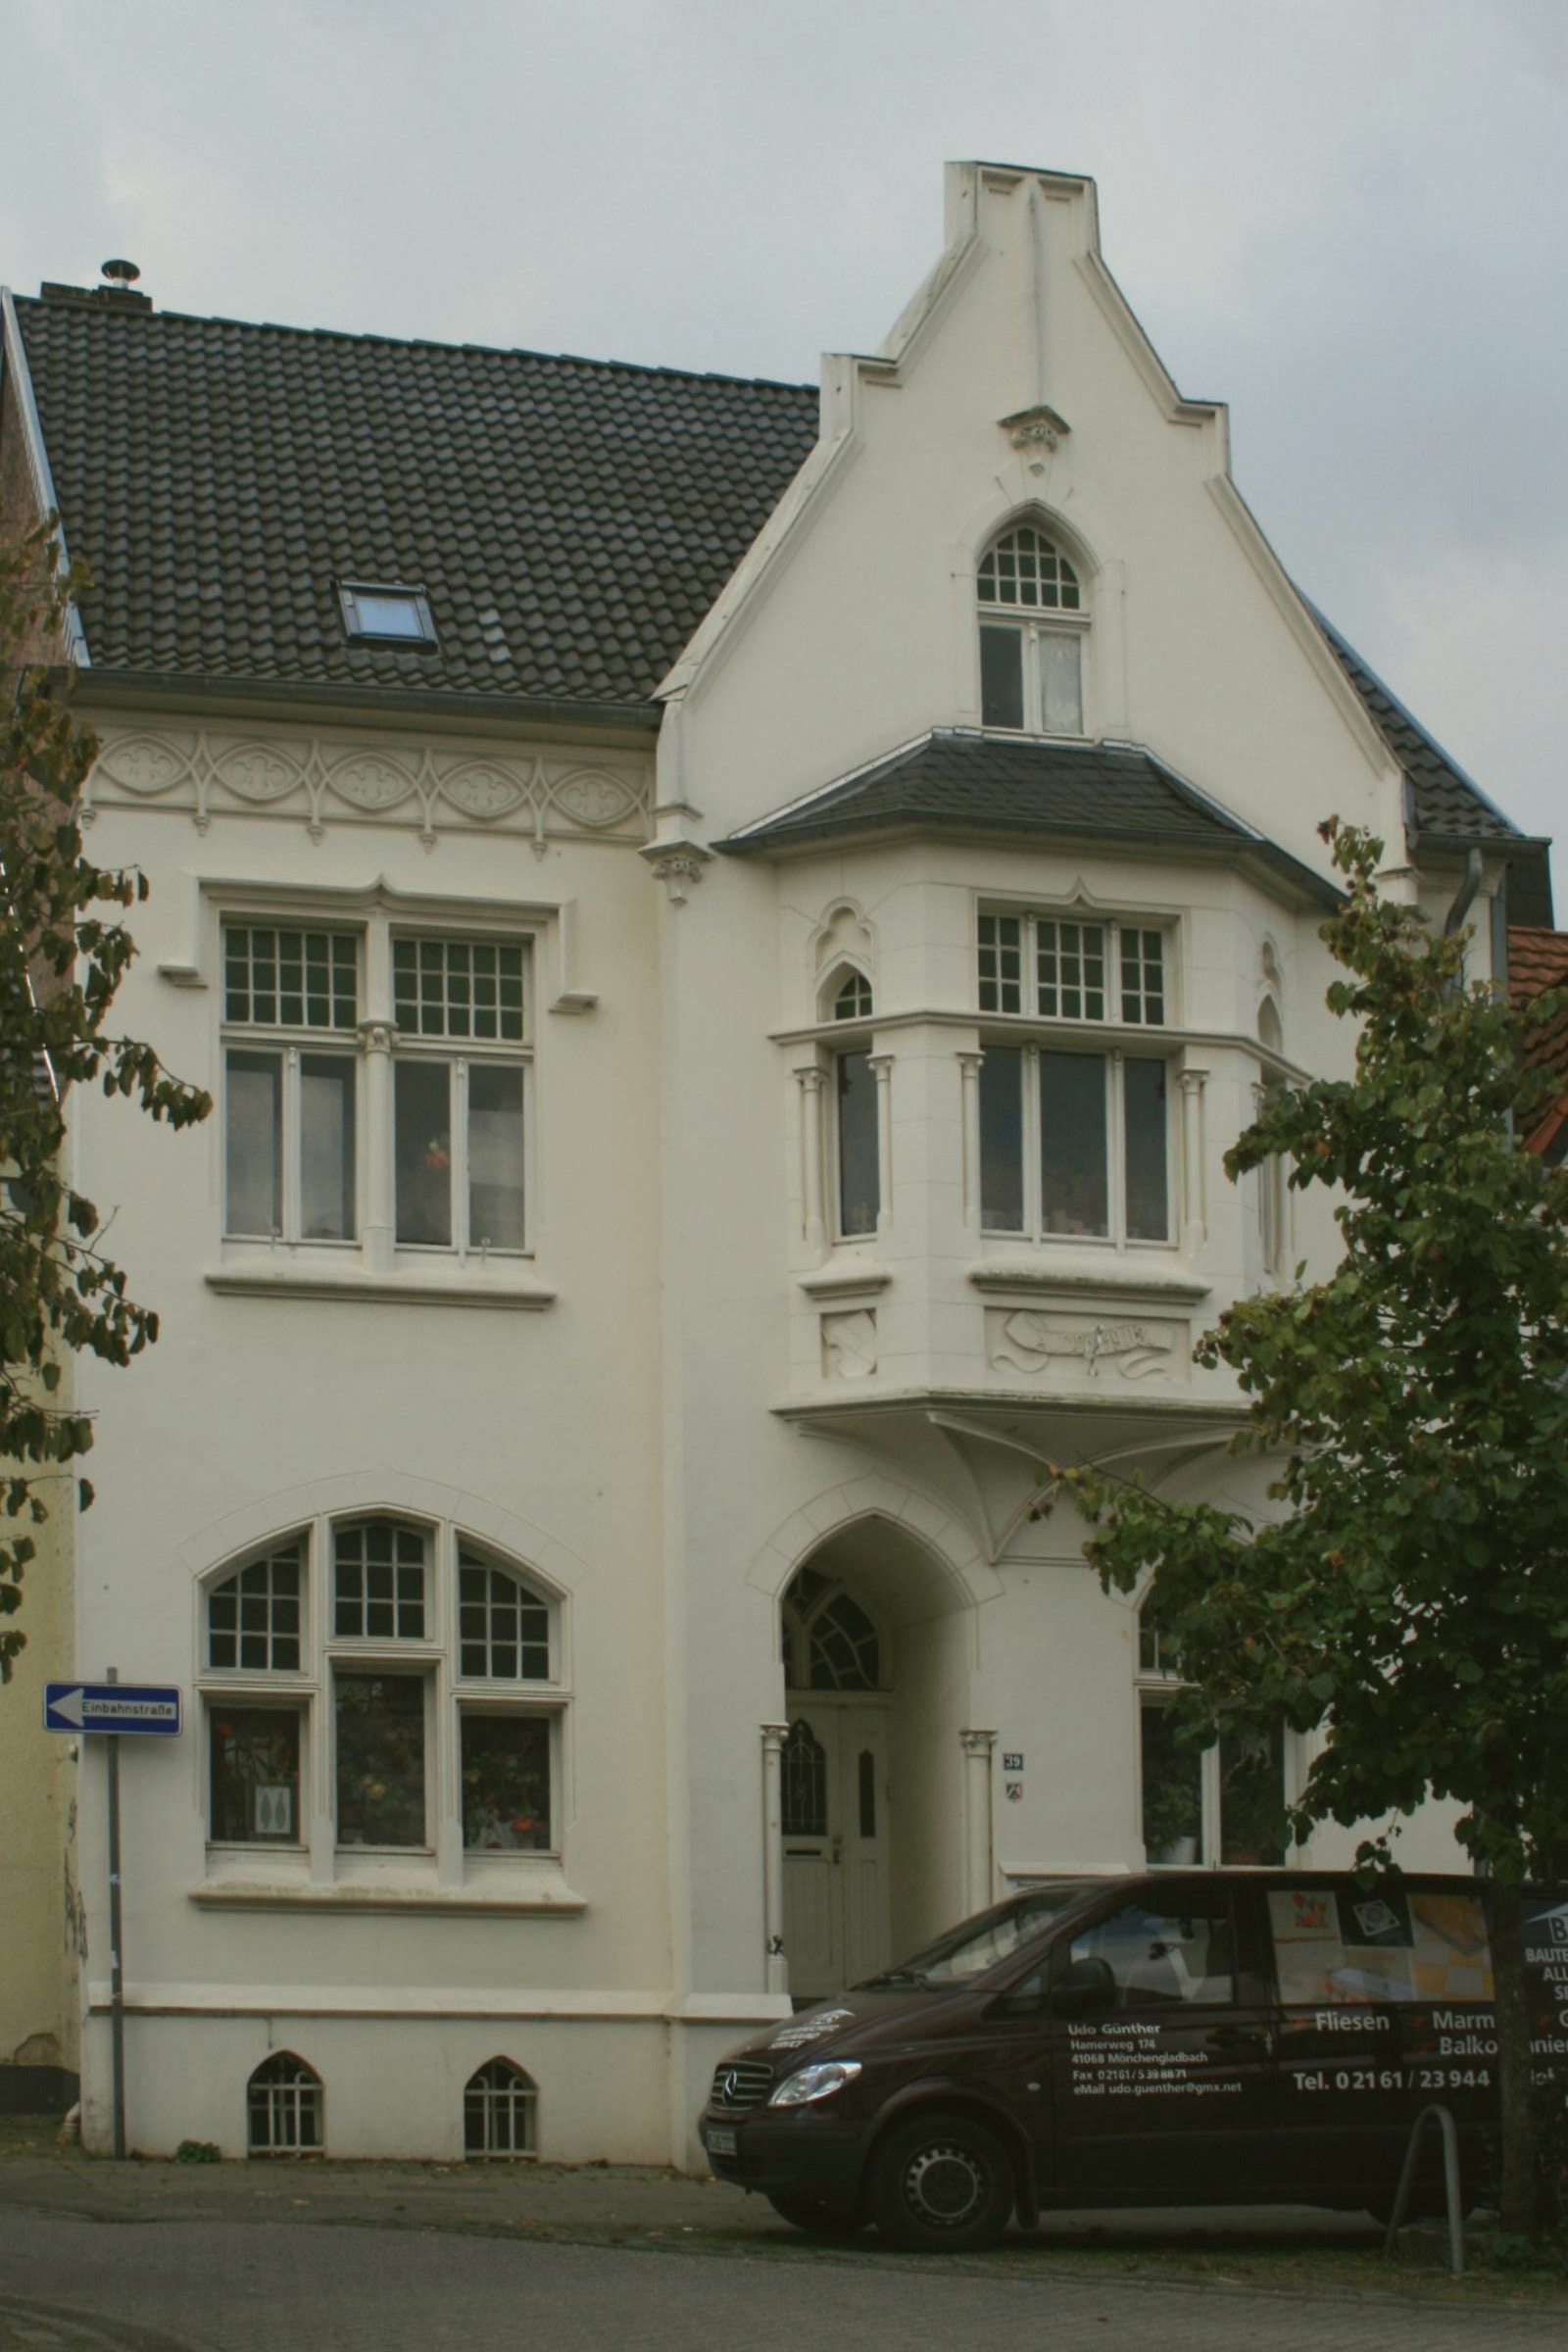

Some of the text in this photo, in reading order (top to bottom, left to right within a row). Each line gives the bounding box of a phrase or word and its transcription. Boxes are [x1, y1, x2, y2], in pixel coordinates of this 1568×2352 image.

[81, 1701, 173, 1715] Einbahnstraße
[1005, 1755, 1020, 1767] 39
[1314, 2011, 1495, 2032] Fliesen Marm
[1068, 2023, 1161, 2035] Udo Günther
[1070, 2038, 1156, 2052] Hamerweg 174
[1440, 2035, 1498, 2055] Balko
[1071, 2051, 1208, 2066] 41068 Mönchengladbach
[1072, 2070, 1093, 2081] Fax
[1293, 2072, 1329, 2090] Tel.
[1074, 2082, 1243, 2096] eMail udo.guenther@gmx.net
